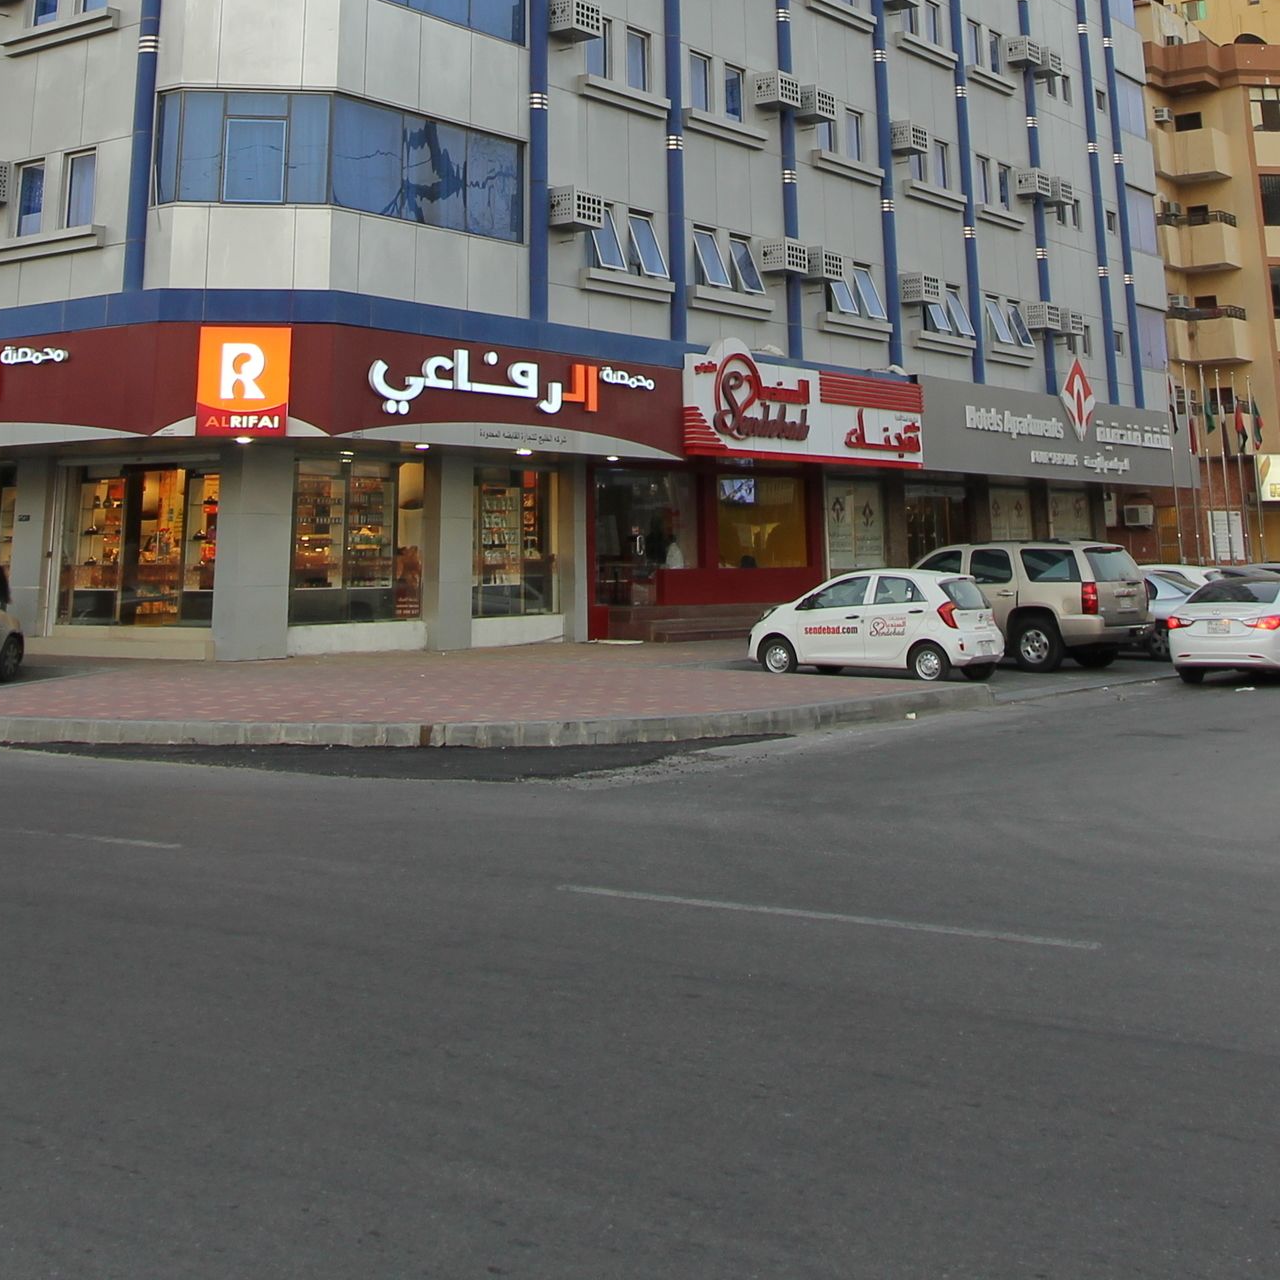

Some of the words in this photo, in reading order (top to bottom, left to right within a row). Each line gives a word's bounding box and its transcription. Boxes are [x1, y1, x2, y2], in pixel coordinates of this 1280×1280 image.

[220, 343, 265, 399] R
[368, 349, 598, 414] الرفاعي
[804, 625, 858, 635] sendebad.com
